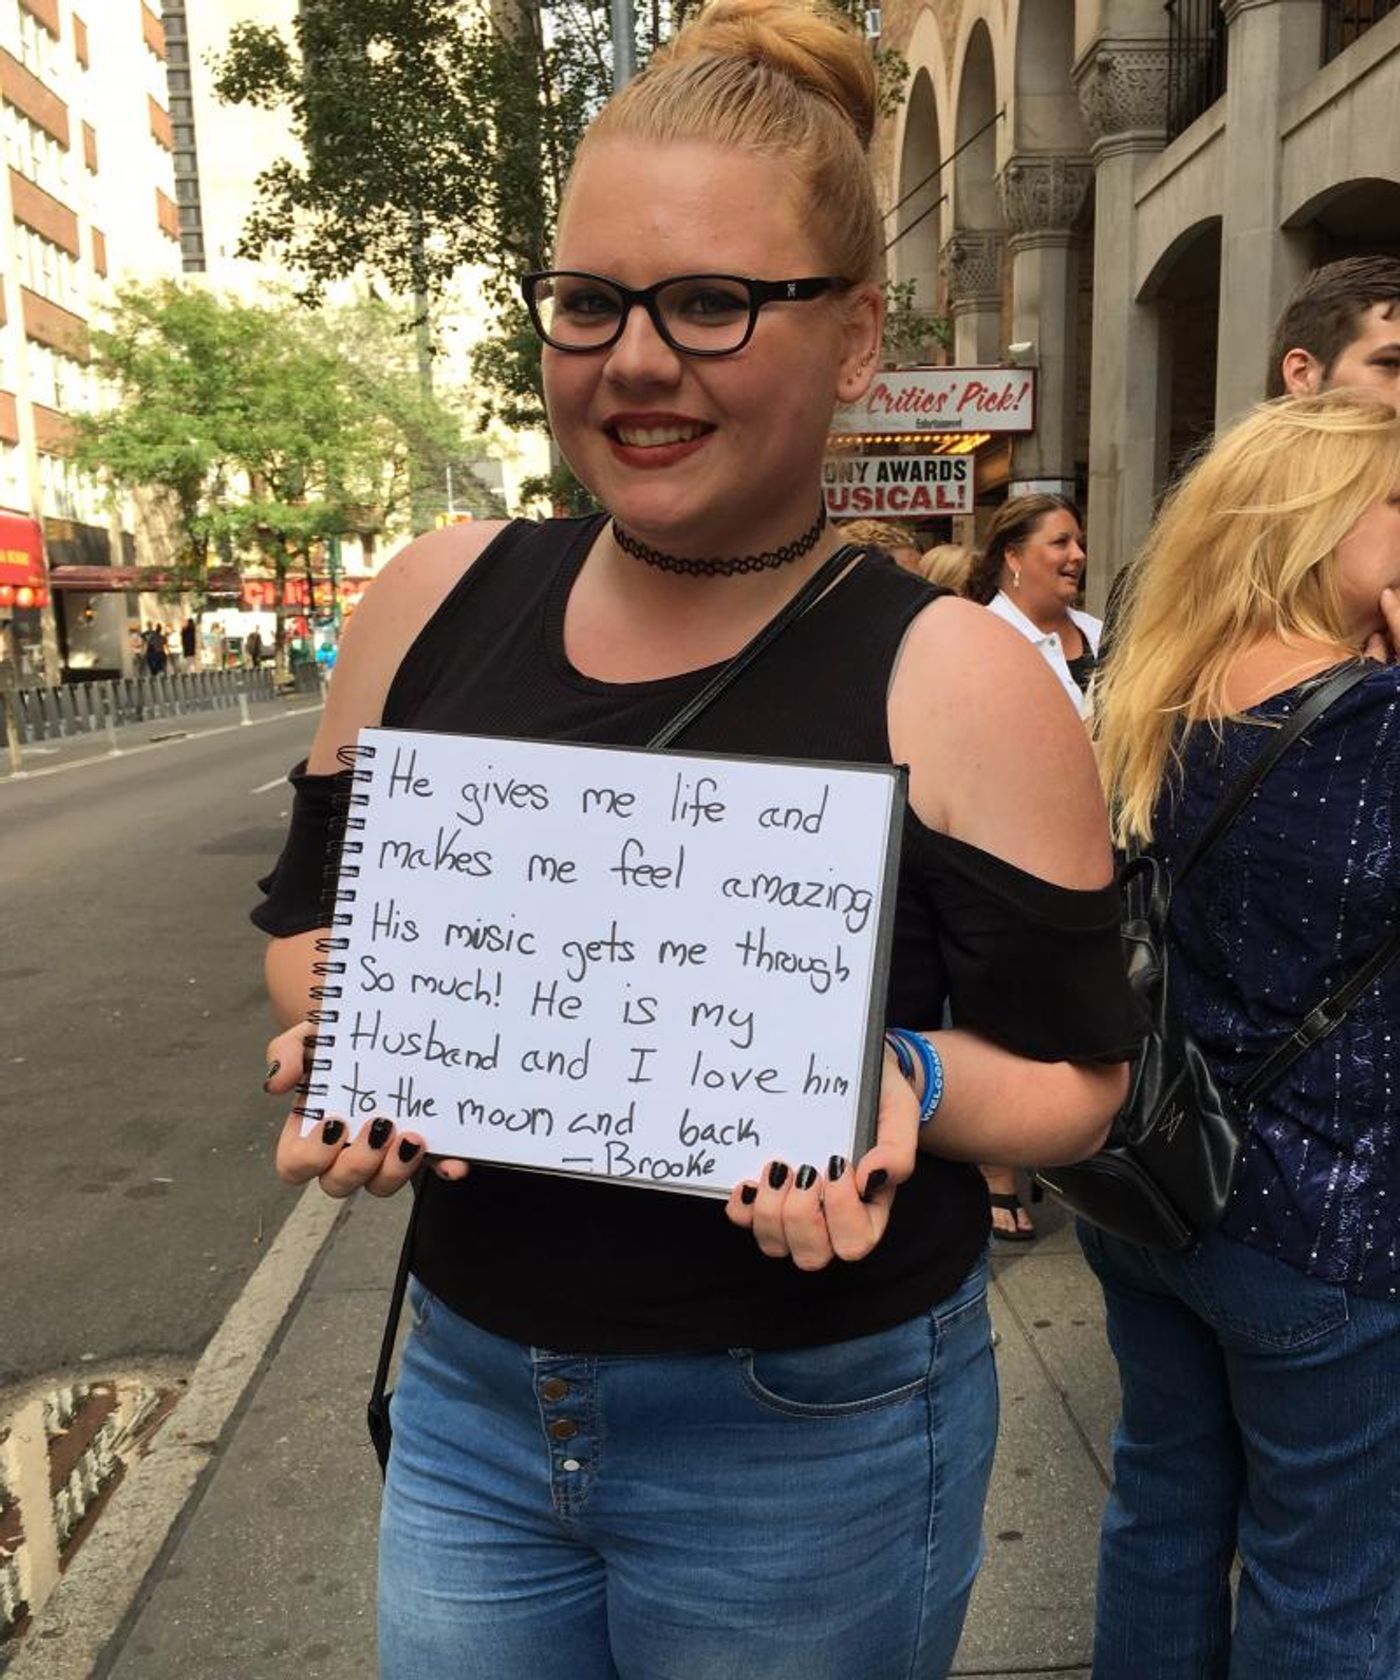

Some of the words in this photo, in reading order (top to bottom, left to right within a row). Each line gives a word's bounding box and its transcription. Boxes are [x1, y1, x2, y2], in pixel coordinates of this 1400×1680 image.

[867, 383, 956, 414] Critics'
[956, 381, 1030, 413] Pick!
[824, 461, 869, 484] ONY
[876, 460, 967, 483] AWARDS
[827, 485, 966, 512] USICAL!
[389, 747, 433, 798] He
[456, 765, 549, 826] gives
[583, 789, 635, 818] me
[672, 772, 725, 826] life
[758, 784, 829, 834] and
[379, 826, 492, 877] makes
[528, 854, 577, 883] me
[610, 838, 684, 889] feel
[722, 868, 872, 934] amazing
[372, 899, 419, 942] His
[445, 914, 536, 955] music
[562, 920, 635, 983] gets
[659, 940, 707, 967] me
[735, 926, 850, 994] through
[411, 971, 501, 1007] much!
[531, 980, 582, 1019] He
[623, 983, 657, 1025] is
[691, 1003, 753, 1049] my
[350, 1009, 500, 1070] Husband
[521, 1038, 591, 1080] and
[627, 1048, 657, 1083] I
[691, 1050, 786, 1093] love
[803, 1053, 848, 1096] him
[341, 1062, 377, 1116] to
[387, 1076, 438, 1117] the
[457, 1102, 553, 1136] moon
[567, 1101, 636, 1136] and
[679, 1108, 760, 1147] back
[605, 1141, 715, 1178] Brooke
